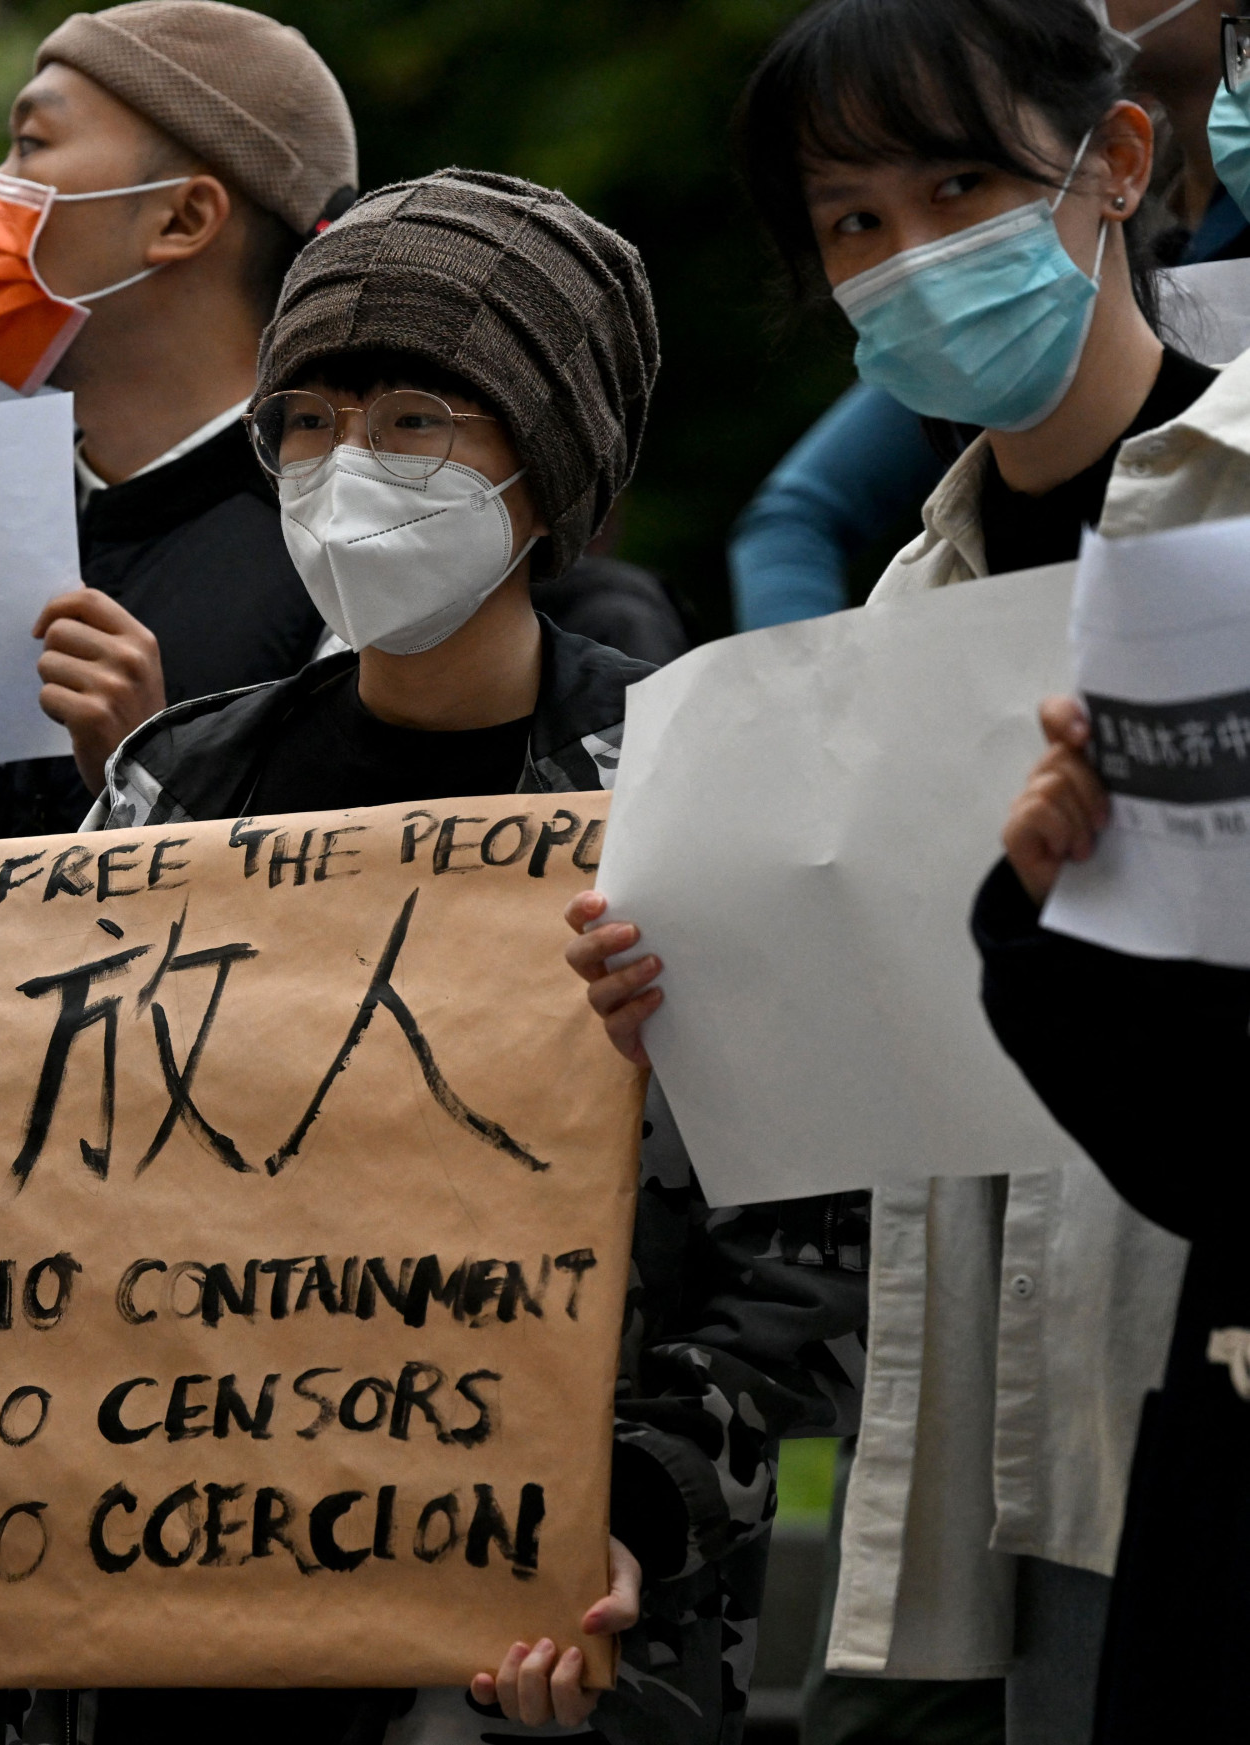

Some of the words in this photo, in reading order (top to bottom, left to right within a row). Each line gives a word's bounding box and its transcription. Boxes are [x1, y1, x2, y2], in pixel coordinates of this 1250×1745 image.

[229, 815, 368, 889] THE
[400, 808, 607, 879] PEOPL
[7, 887, 550, 1196] 放人
[116, 1248, 598, 1328] CONTAINMENT
[96, 1361, 503, 1448] CENSORS
